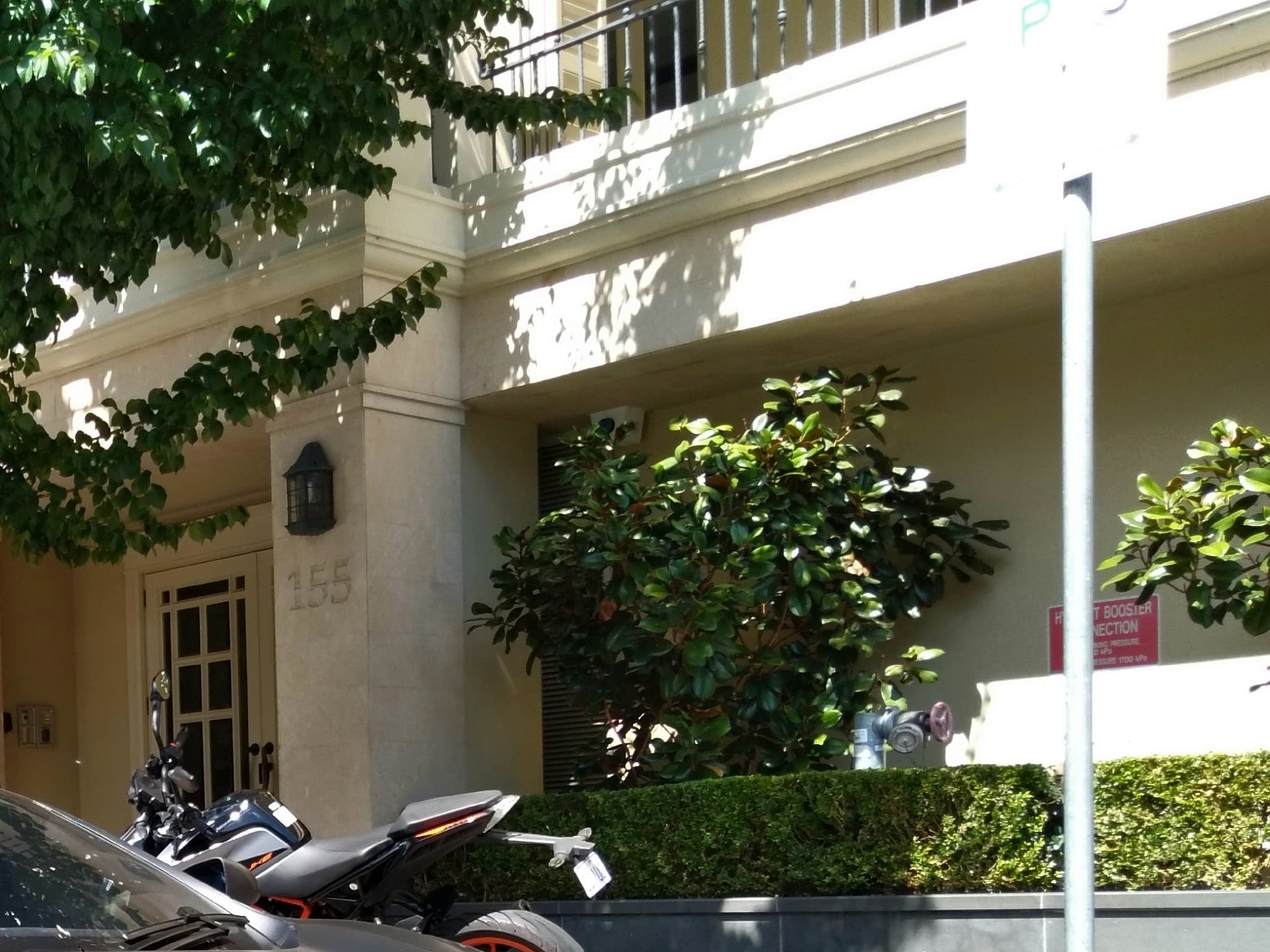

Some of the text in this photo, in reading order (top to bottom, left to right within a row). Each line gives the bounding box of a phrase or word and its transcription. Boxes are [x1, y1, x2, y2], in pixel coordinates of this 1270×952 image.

[288, 557, 352, 611] 155
[1105, 602, 1152, 619] BOOSTER
[1093, 620, 1138, 637] NECTION
